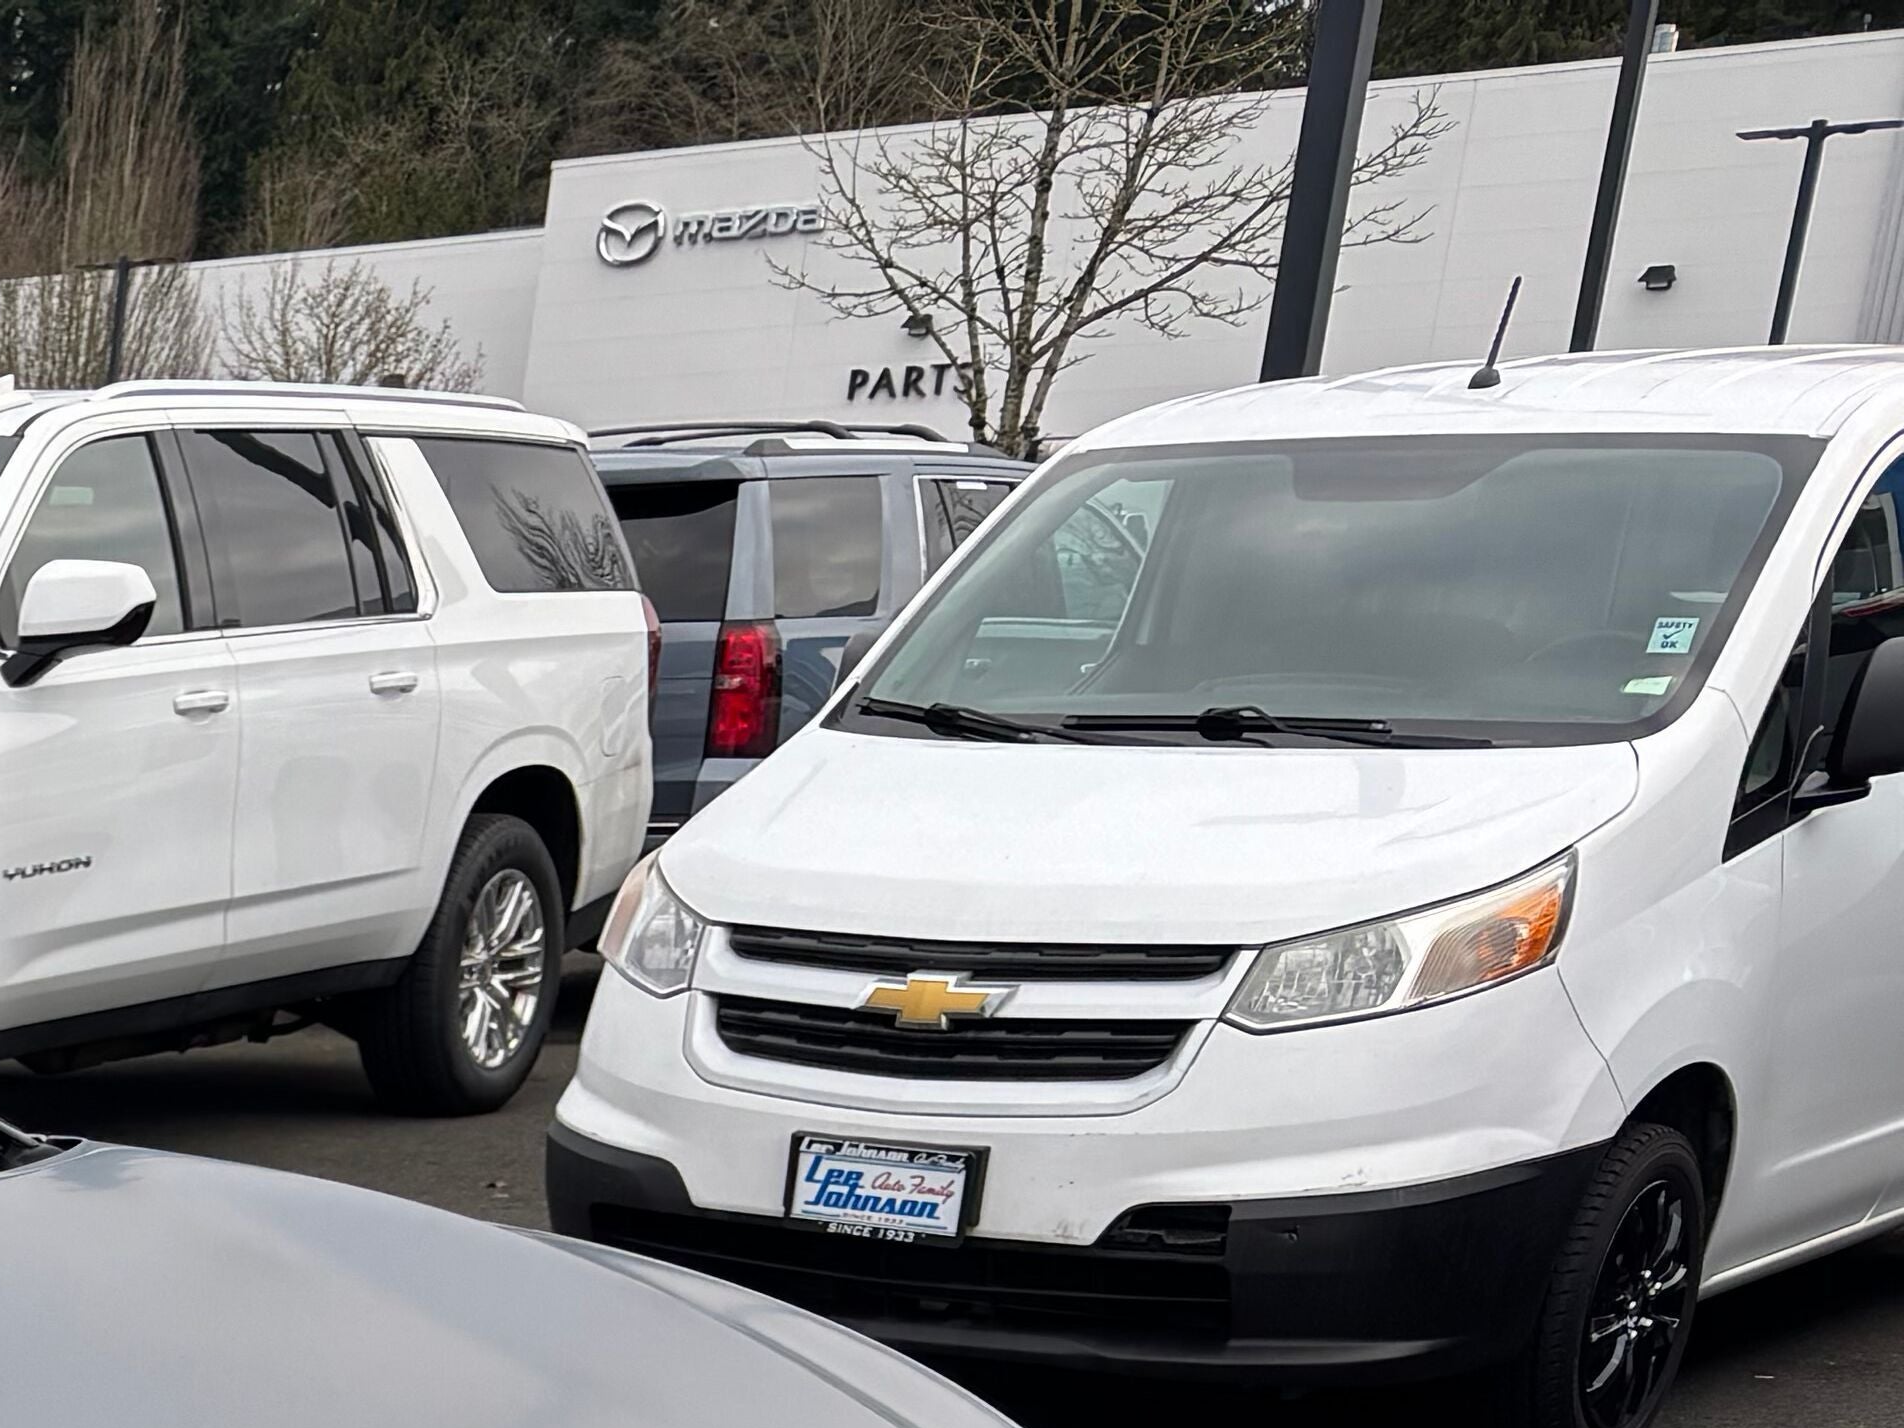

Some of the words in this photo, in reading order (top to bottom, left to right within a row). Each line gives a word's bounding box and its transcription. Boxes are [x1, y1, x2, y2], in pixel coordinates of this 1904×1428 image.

[674, 205, 826, 246] mazda
[1656, 621, 1694, 629] SAFETY
[1660, 640, 1679, 649] OK
[2, 855, 93, 881] YUKON
[799, 1135, 835, 1154] Lee
[835, 1140, 911, 1163] Johnson
[804, 1155, 865, 1187] Lee
[871, 1171, 906, 1193] Auto
[909, 1174, 955, 1204] Family
[804, 1180, 941, 1220] Johnson
[842, 1212, 873, 1222] SINCE
[878, 1216, 904, 1225] 1933
[826, 1222, 873, 1238] SINCE
[877, 1228, 915, 1243] 1933
